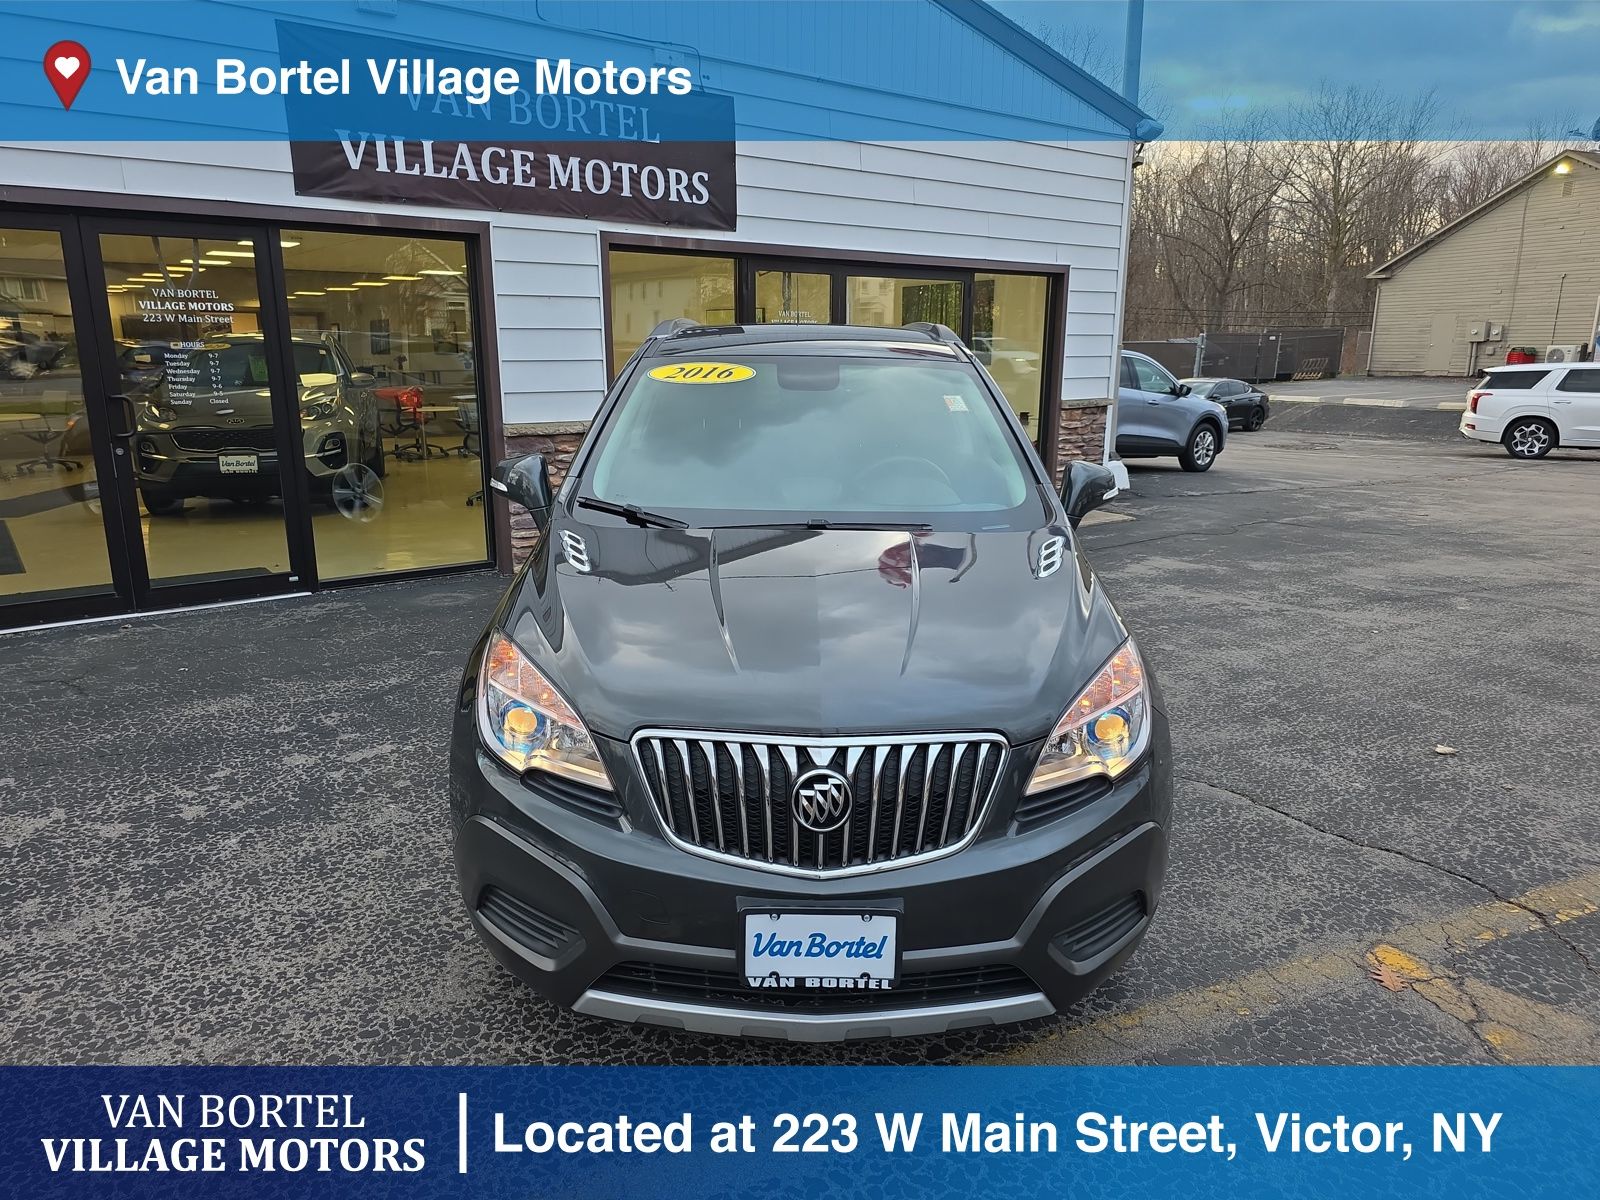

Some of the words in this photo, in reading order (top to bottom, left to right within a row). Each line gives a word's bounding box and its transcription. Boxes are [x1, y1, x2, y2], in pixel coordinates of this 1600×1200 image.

[508, 87, 661, 144] BORTEL
[335, 128, 536, 188] VILLAGE
[547, 154, 710, 205] MOTORS
[152, 288, 175, 298] VAN
[177, 289, 219, 299] BORTEL
[139, 300, 186, 311] VILLAGE
[188, 302, 235, 312] MOTORS
[142, 313, 162, 323] 223
[164, 314, 176, 323] W
[178, 314, 203, 323] Main
[205, 315, 234, 324] Street
[778, 310, 790, 318] VAN
[180, 341, 205, 349] HOURS
[165, 360, 190, 368] Tuesday
[664, 366, 738, 379] 2016
[753, 932, 803, 958] Van
[804, 932, 889, 960] Bortel
[747, 976, 796, 988] VAN
[805, 977, 893, 990] BORTEL
